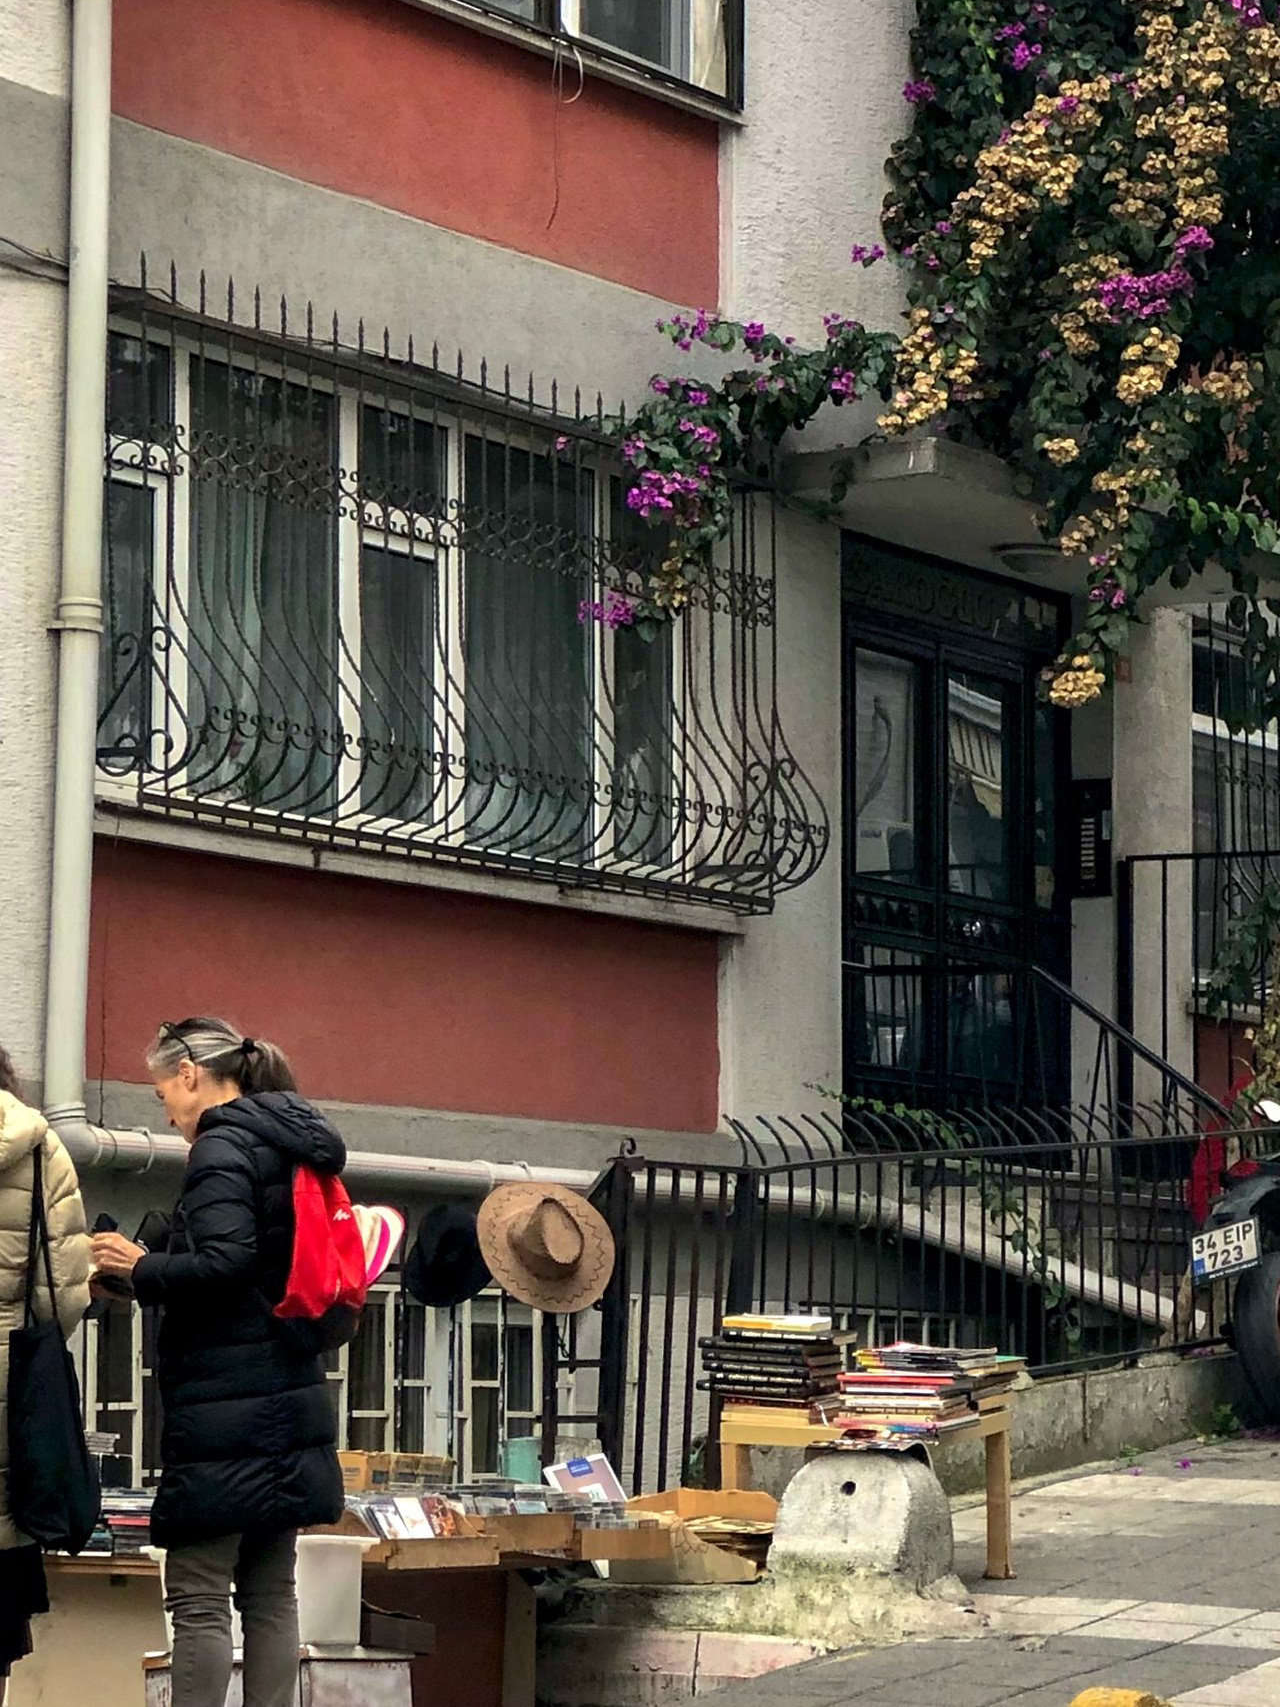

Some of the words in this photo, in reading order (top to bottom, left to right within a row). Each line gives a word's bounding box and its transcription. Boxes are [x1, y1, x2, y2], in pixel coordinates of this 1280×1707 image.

[1195, 1234, 1217, 1254] 34
[1223, 1223, 1253, 1245] EIP
[1208, 1245, 1244, 1269] 723
